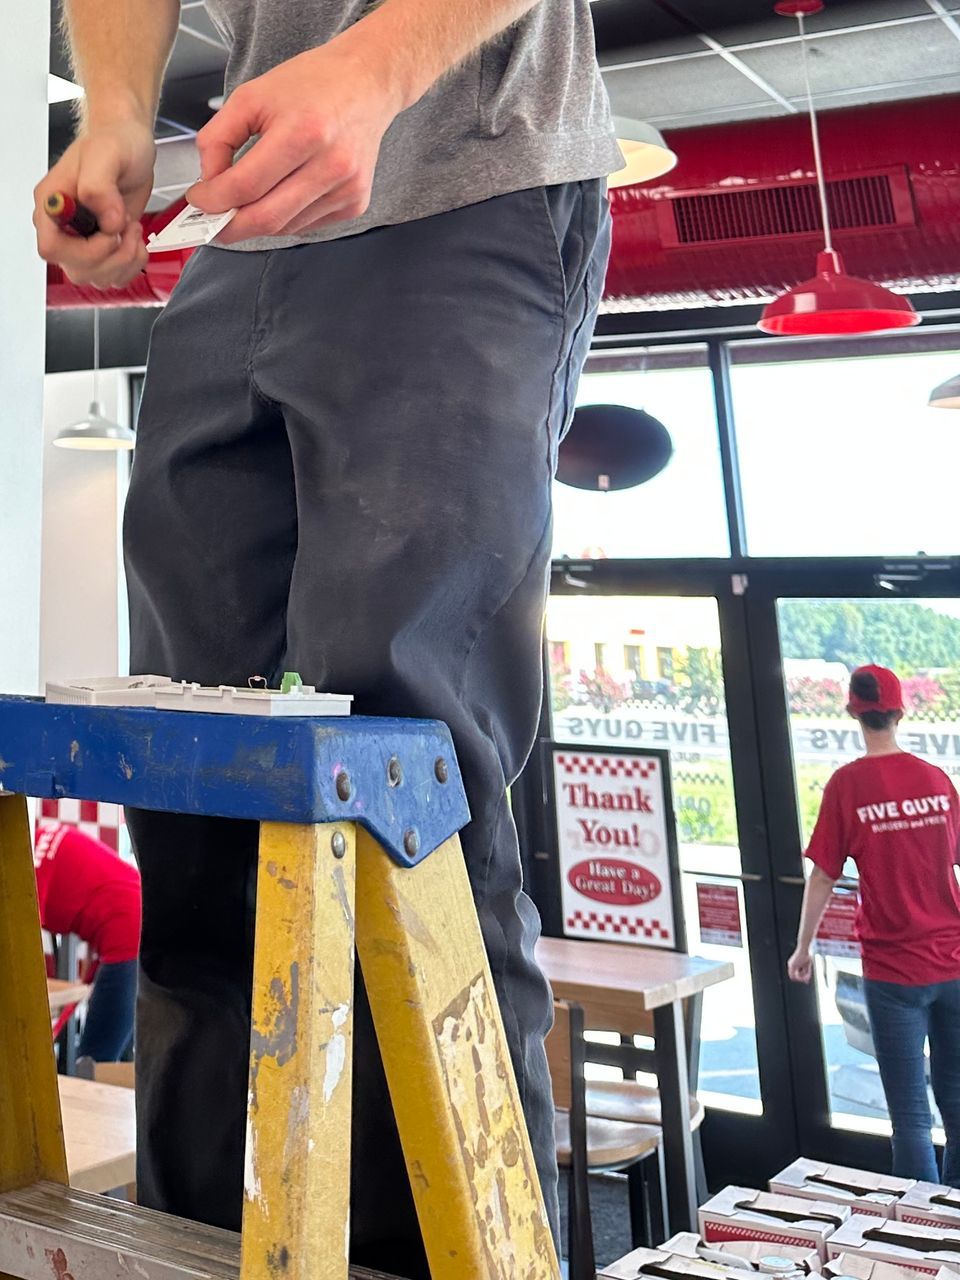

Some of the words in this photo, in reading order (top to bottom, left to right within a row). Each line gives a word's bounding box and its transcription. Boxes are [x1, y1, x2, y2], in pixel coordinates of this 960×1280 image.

[562, 782, 653, 815] Thank
[856, 801, 900, 823] FIVE
[902, 794, 950, 817] GUYS
[577, 818, 641, 848] You!
[589, 860, 627, 880] Have
[631, 869, 640, 880] a
[575, 875, 616, 894] Great
[622, 880, 656, 901] Day!
